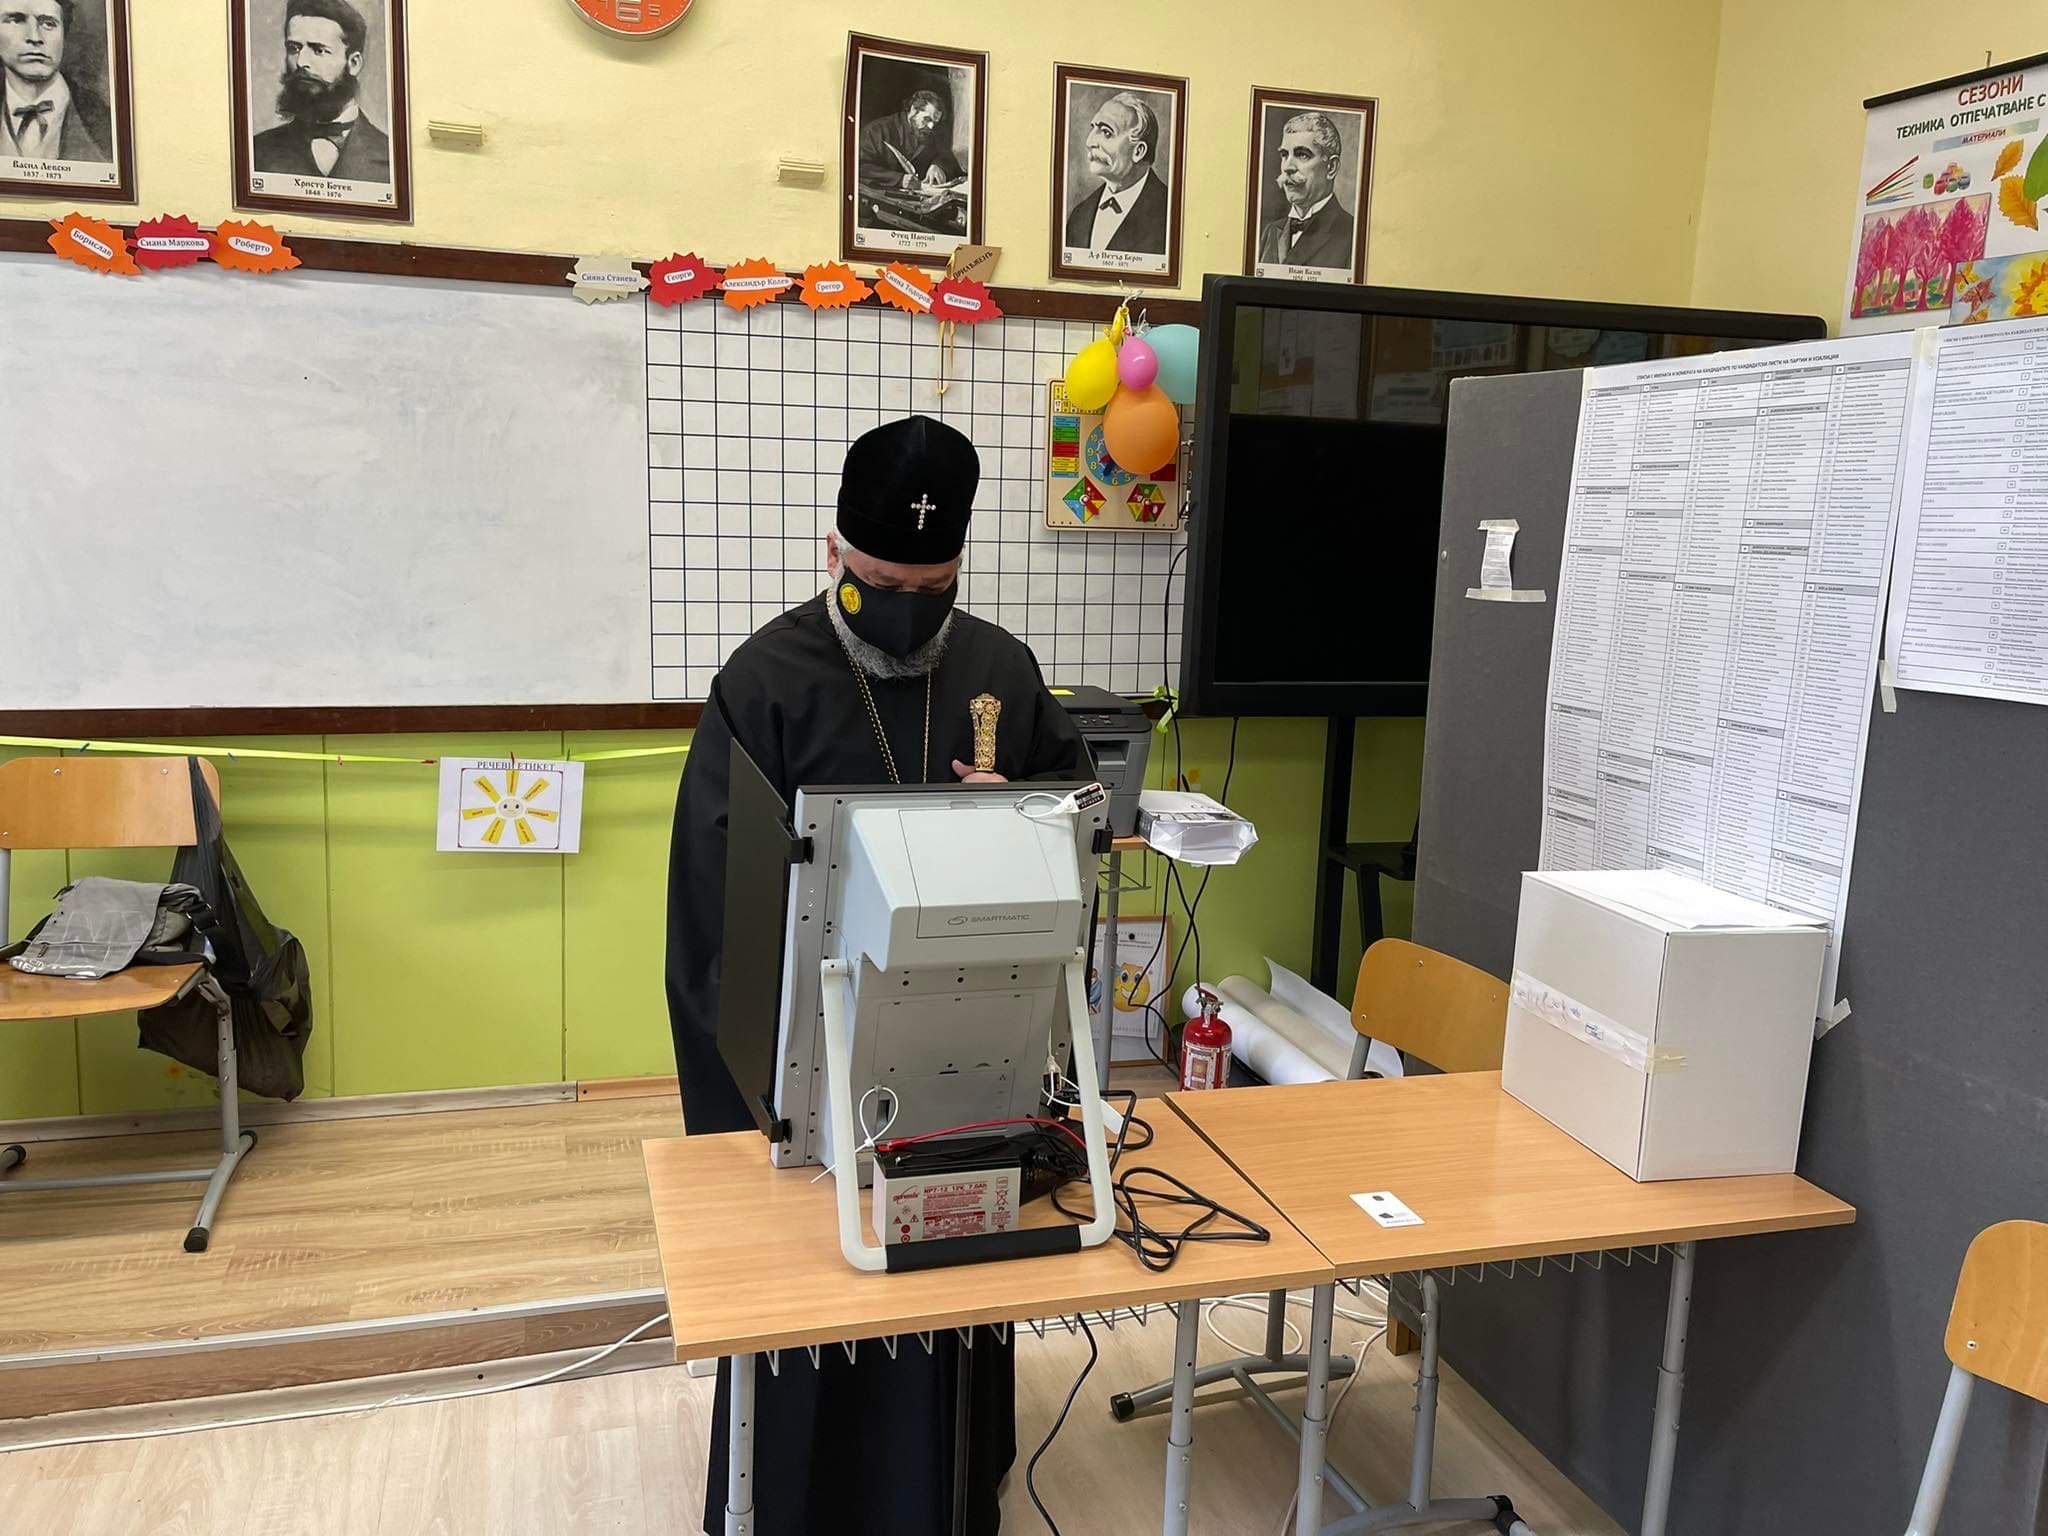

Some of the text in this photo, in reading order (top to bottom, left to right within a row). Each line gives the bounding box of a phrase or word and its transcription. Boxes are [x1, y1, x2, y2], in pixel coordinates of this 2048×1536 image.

[1958, 74, 2024, 106] СЕЗОНИ
[1896, 94, 2046, 139] ТЕХНИКА ОТПЕЧАТВАНЕ С
[1962, 129, 2006, 144] МАТЕРИАЛИ
[12, 160, 71, 172] Васил Левски
[294, 178, 352, 191] Христо Ботев
[73, 231, 112, 257] Борислав
[168, 239, 205, 248] Маркова
[235, 238, 271, 253] Роберто
[606, 274, 638, 283] Станева
[666, 271, 693, 282] Георги
[724, 279, 766, 288] Александър
[947, 295, 980, 308] Живомир
[517, 762, 554, 771] ЕТИКЕТ
[970, 914, 1031, 923] SMARTMATIC
